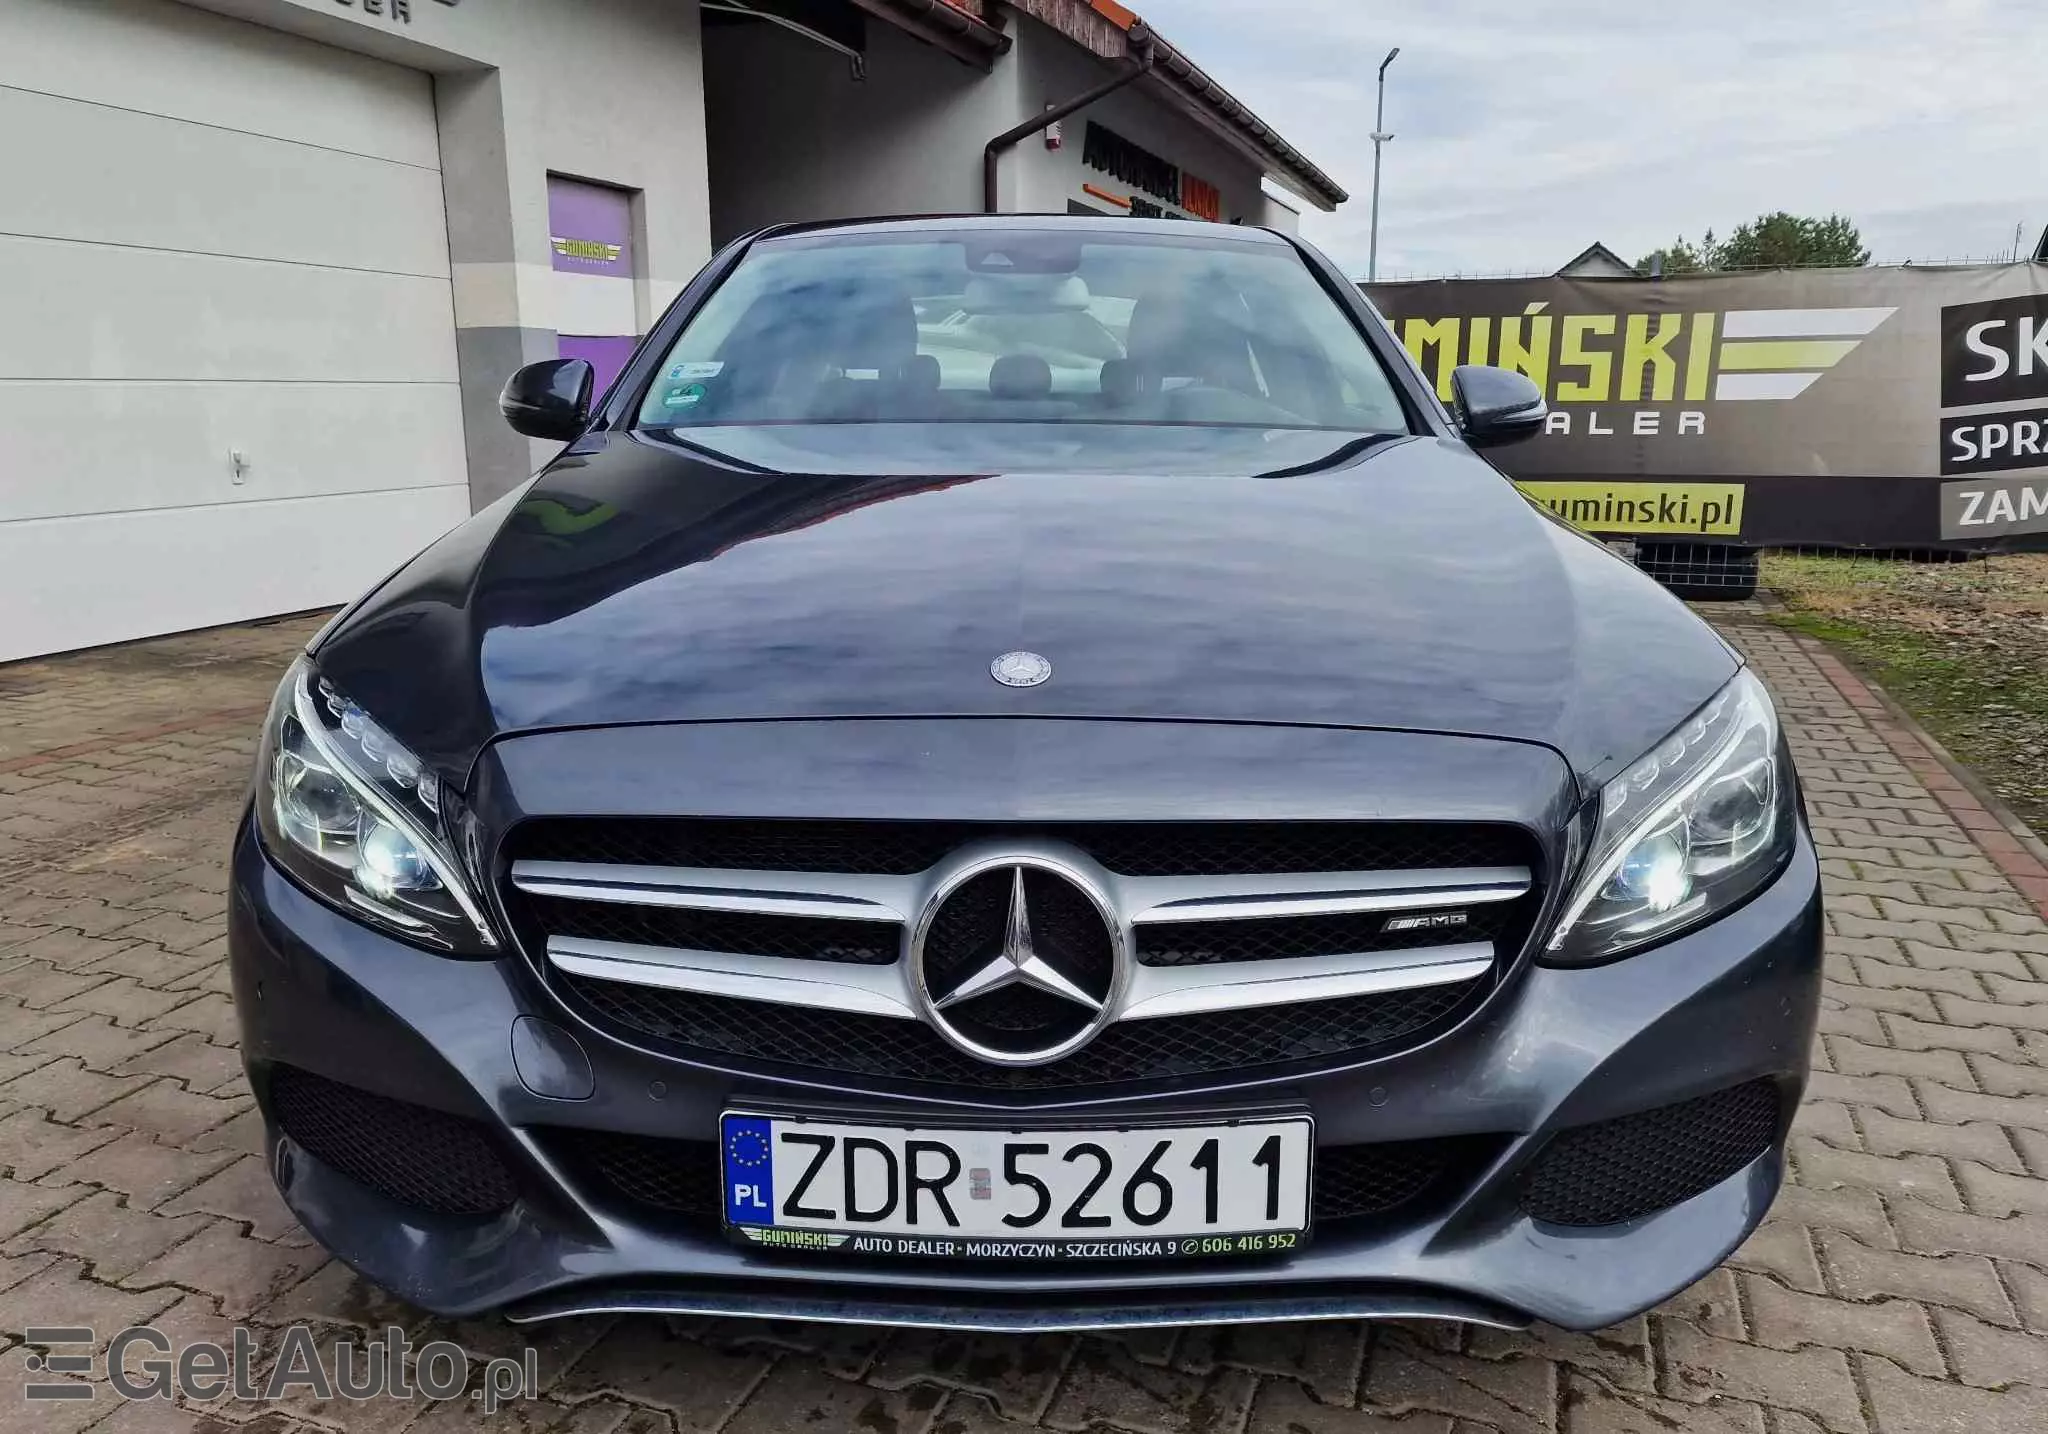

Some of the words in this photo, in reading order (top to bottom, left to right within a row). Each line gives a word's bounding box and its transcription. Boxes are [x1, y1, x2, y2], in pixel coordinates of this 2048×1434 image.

[1385, 302, 1715, 401] MIŃSKI
[1951, 420, 2048, 462] SPR
[1541, 493, 1733, 532] uminski.pl
[734, 1184, 767, 1207] PL
[781, 1132, 960, 1227] ZDR
[1001, 1135, 1281, 1227] 52611
[854, 1237, 893, 1253] AUTO
[898, 1239, 955, 1256] DEALER
[966, 1243, 1056, 1257] MORZYCZYN
[1066, 1240, 1162, 1258] SZCZECIŃSKA
[1167, 1241, 1177, 1255] 9
[1202, 1238, 1232, 1253] 606
[1237, 1236, 1263, 1251] 416
[1268, 1233, 1296, 1249] 952
